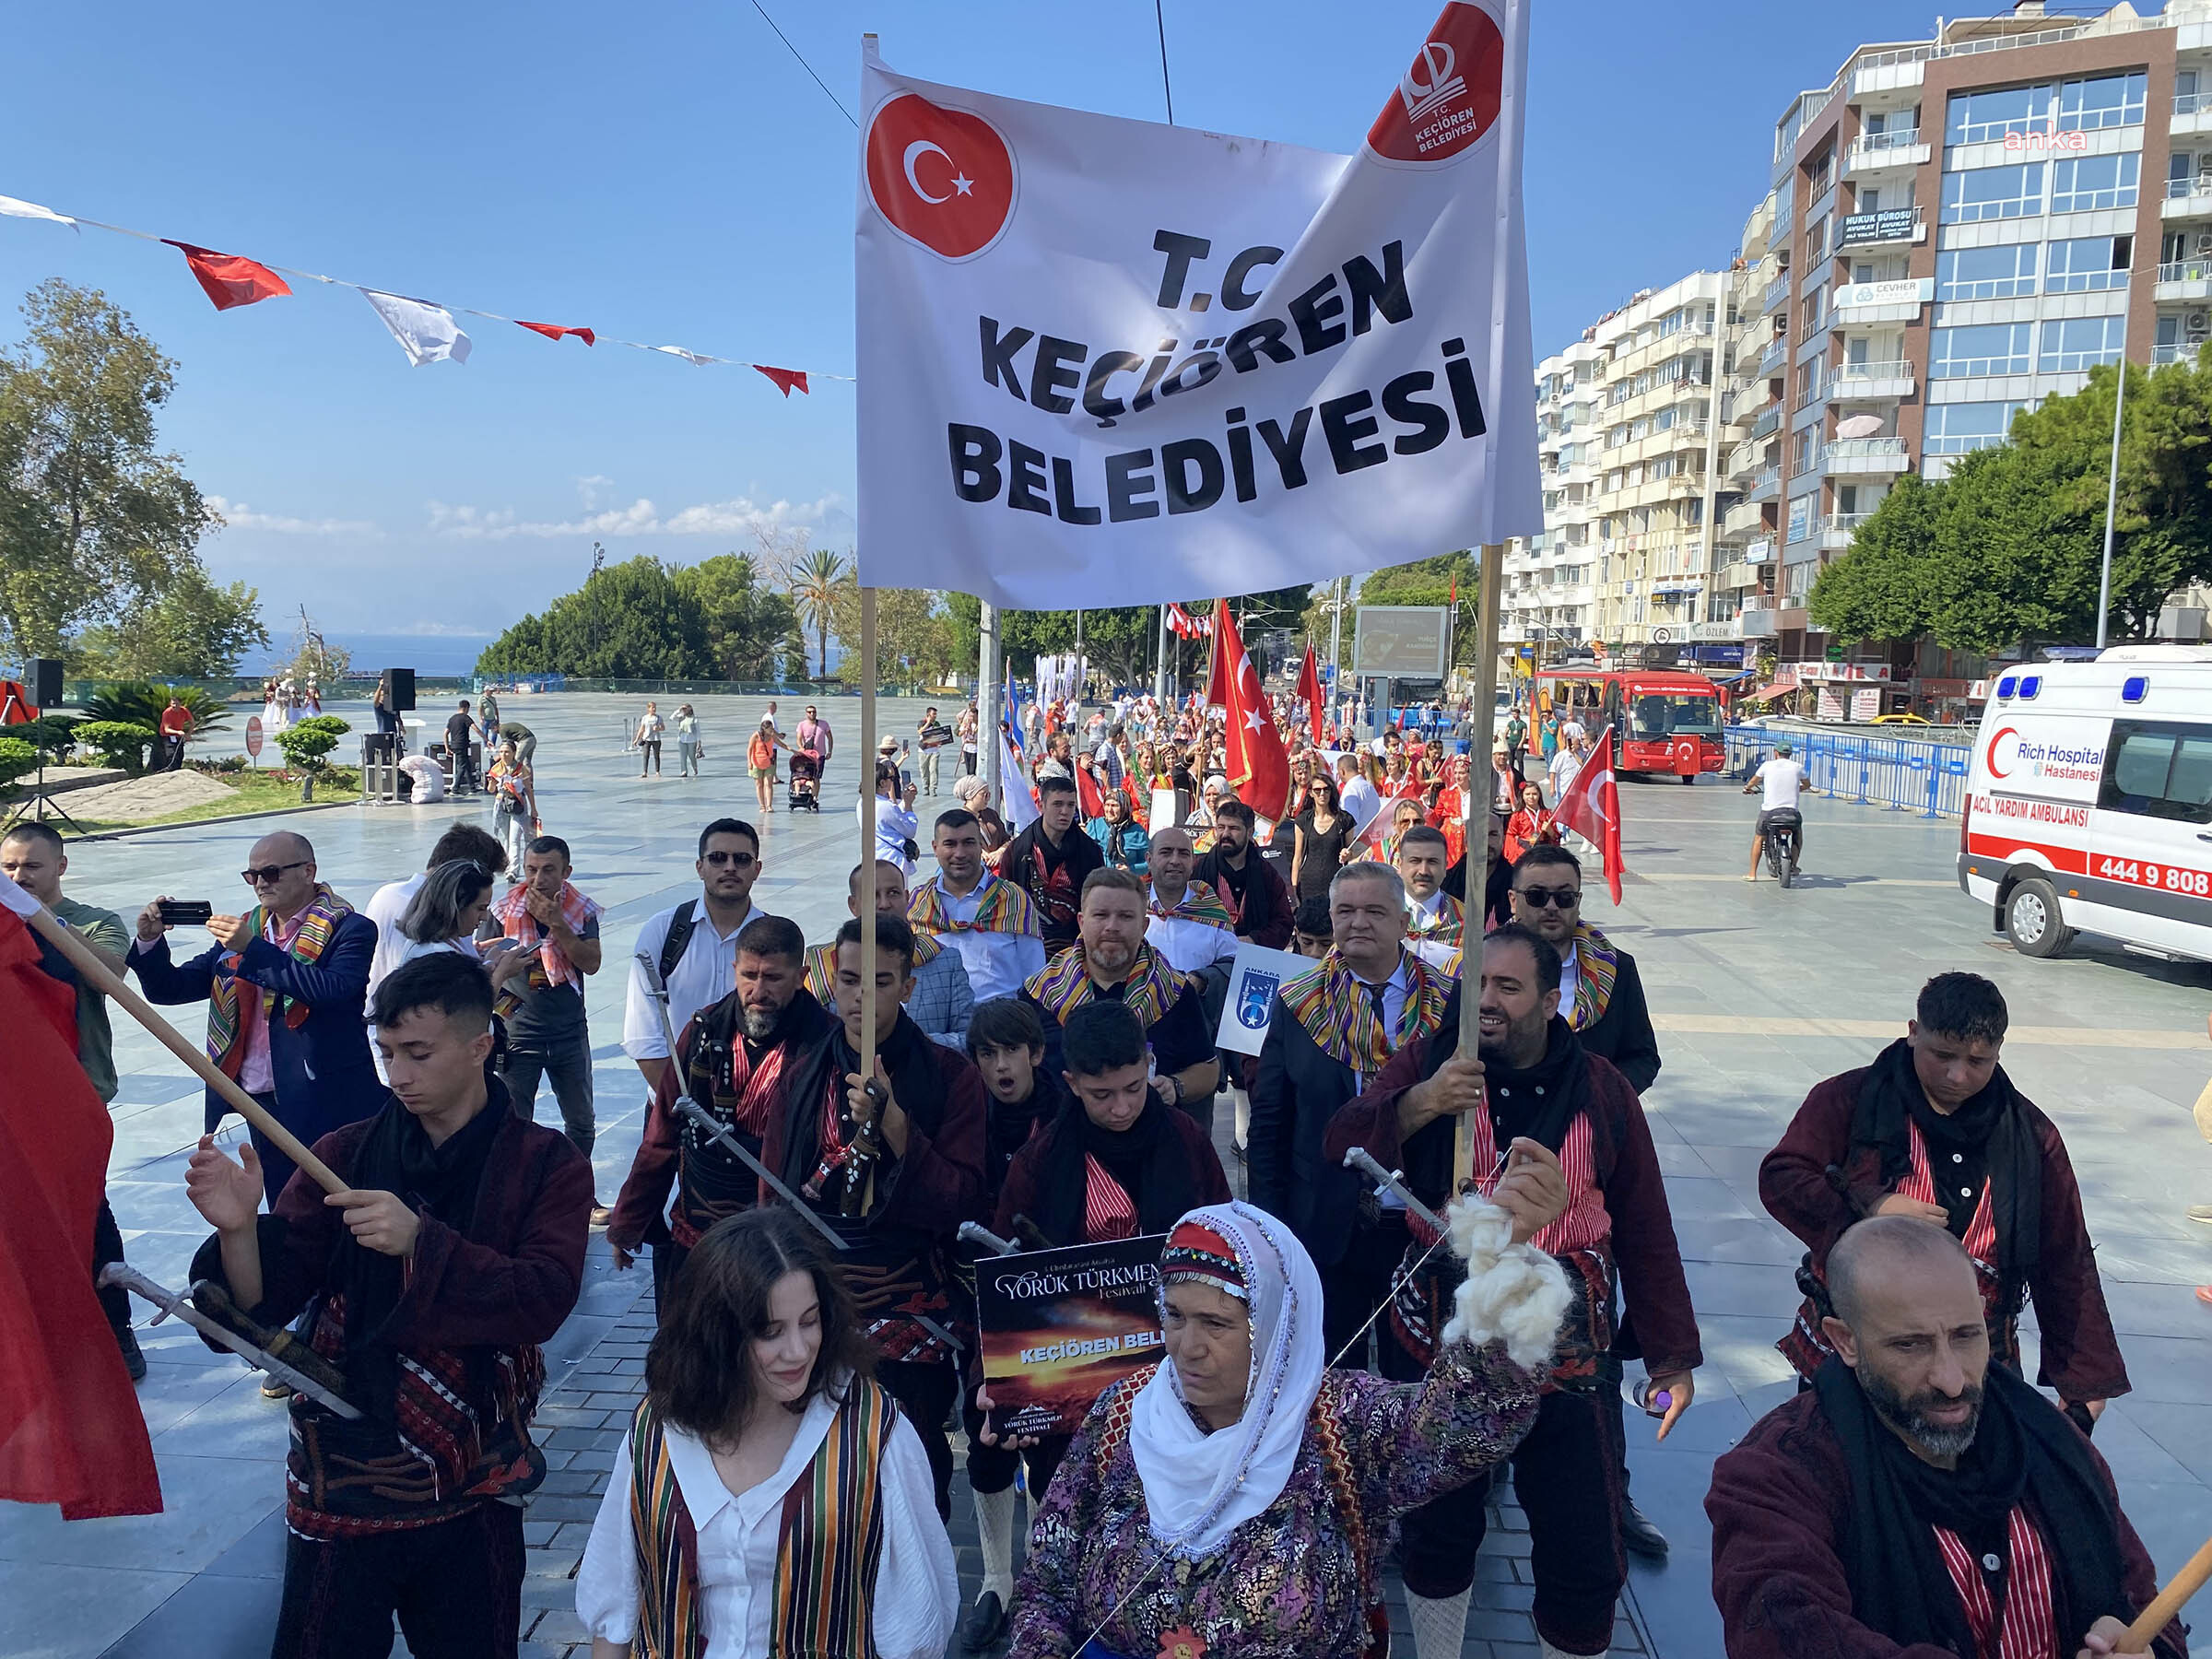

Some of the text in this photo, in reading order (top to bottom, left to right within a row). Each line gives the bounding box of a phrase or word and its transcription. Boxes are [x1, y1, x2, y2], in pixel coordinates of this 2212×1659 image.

[1415, 107, 1475, 142] KEÇİÖREN
[1431, 104, 1452, 118] T.C.
[1418, 120, 1477, 153] BELEDİYESİ
[1845, 210, 1912, 226] HUKUK BÜROSU
[1153, 229, 1285, 312] T.C
[1877, 282, 1916, 293] CEVHER
[979, 239, 1414, 429] KEÇİÖREN
[947, 337, 1487, 525] BELEDİYESİ
[1705, 626, 1729, 637] ÖZLEM
[2018, 743, 2104, 766] Rich Hospital
[2044, 764, 2100, 782] Hastanesi
[1994, 797, 2028, 818] YARDIM
[2030, 803, 2088, 828] AMBULANSI
[2100, 858, 2209, 895] 444 9 808
[1244, 967, 1280, 978] ANKARA
[995, 1270, 1069, 1300] YÖRÜK
[1019, 1335, 1121, 1365] KEÇİÖREN
